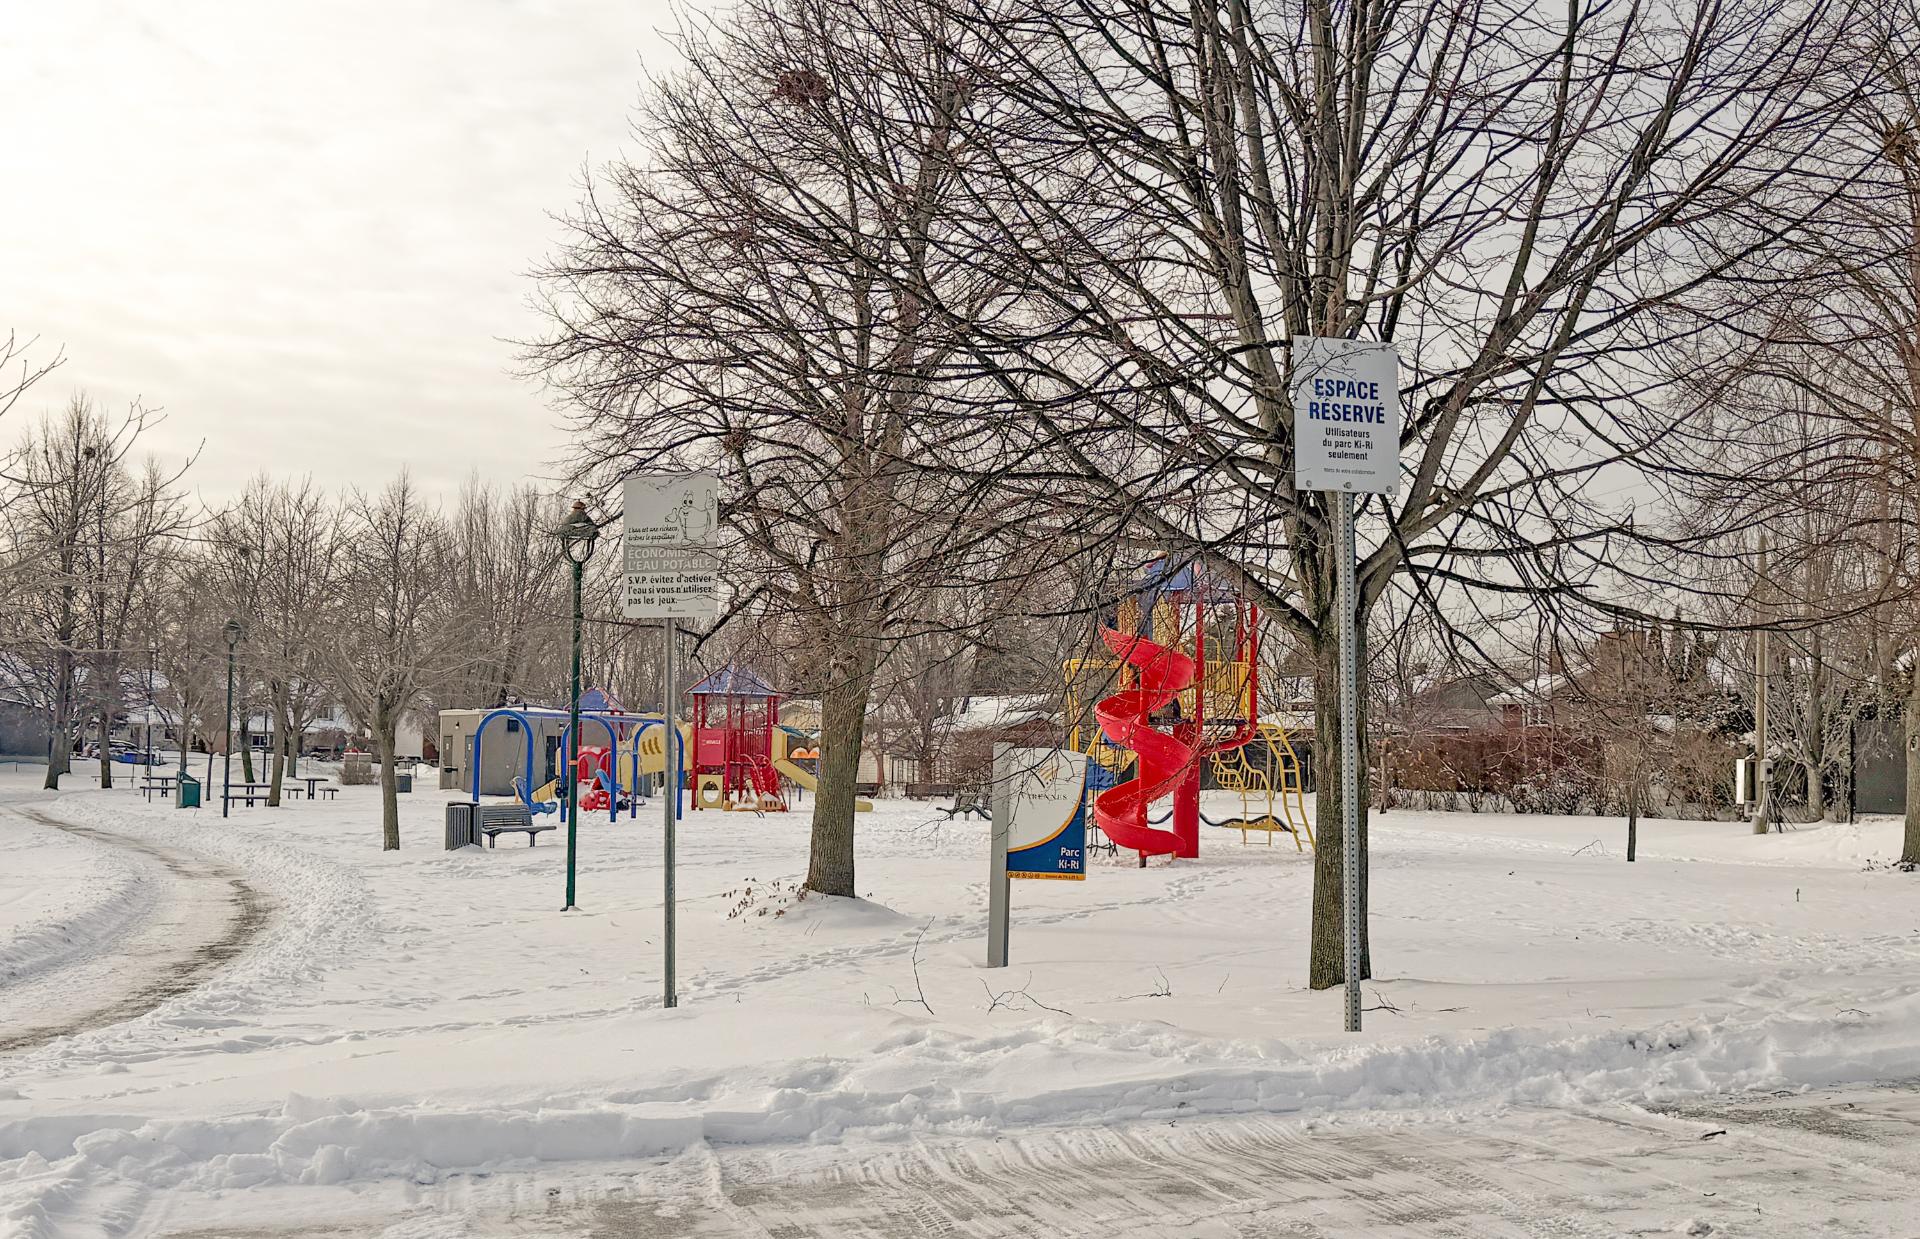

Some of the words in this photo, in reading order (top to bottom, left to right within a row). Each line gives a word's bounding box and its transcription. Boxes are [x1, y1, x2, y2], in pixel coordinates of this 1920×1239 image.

[1315, 378, 1379, 400] ESPACE
[1309, 399, 1385, 424] RÉSERVÉ
[1325, 427, 1370, 439] Utilisateurs
[1322, 438, 1333, 447] du
[1334, 440, 1352, 449] parc
[1354, 440, 1373, 450] Ki-Ri
[1328, 450, 1368, 461] seulement
[628, 547, 706, 559] ÉCONOMISE
[628, 560, 659, 571] L'EAU
[663, 558, 712, 570] POTABLE
[628, 576, 648, 585] S.V.P.
[650, 575, 674, 584] évitez
[676, 574, 712, 583] d'activer
[628, 585, 647, 595] l'eau
[648, 585, 655, 594] si
[676, 584, 712, 593] n'utilisez
[628, 597, 641, 607] pas
[643, 595, 655, 605] les
[658, 595, 678, 607] jeux.
[1060, 847, 1080, 857] Parc
[1058, 859, 1080, 870] Ki-Ri
